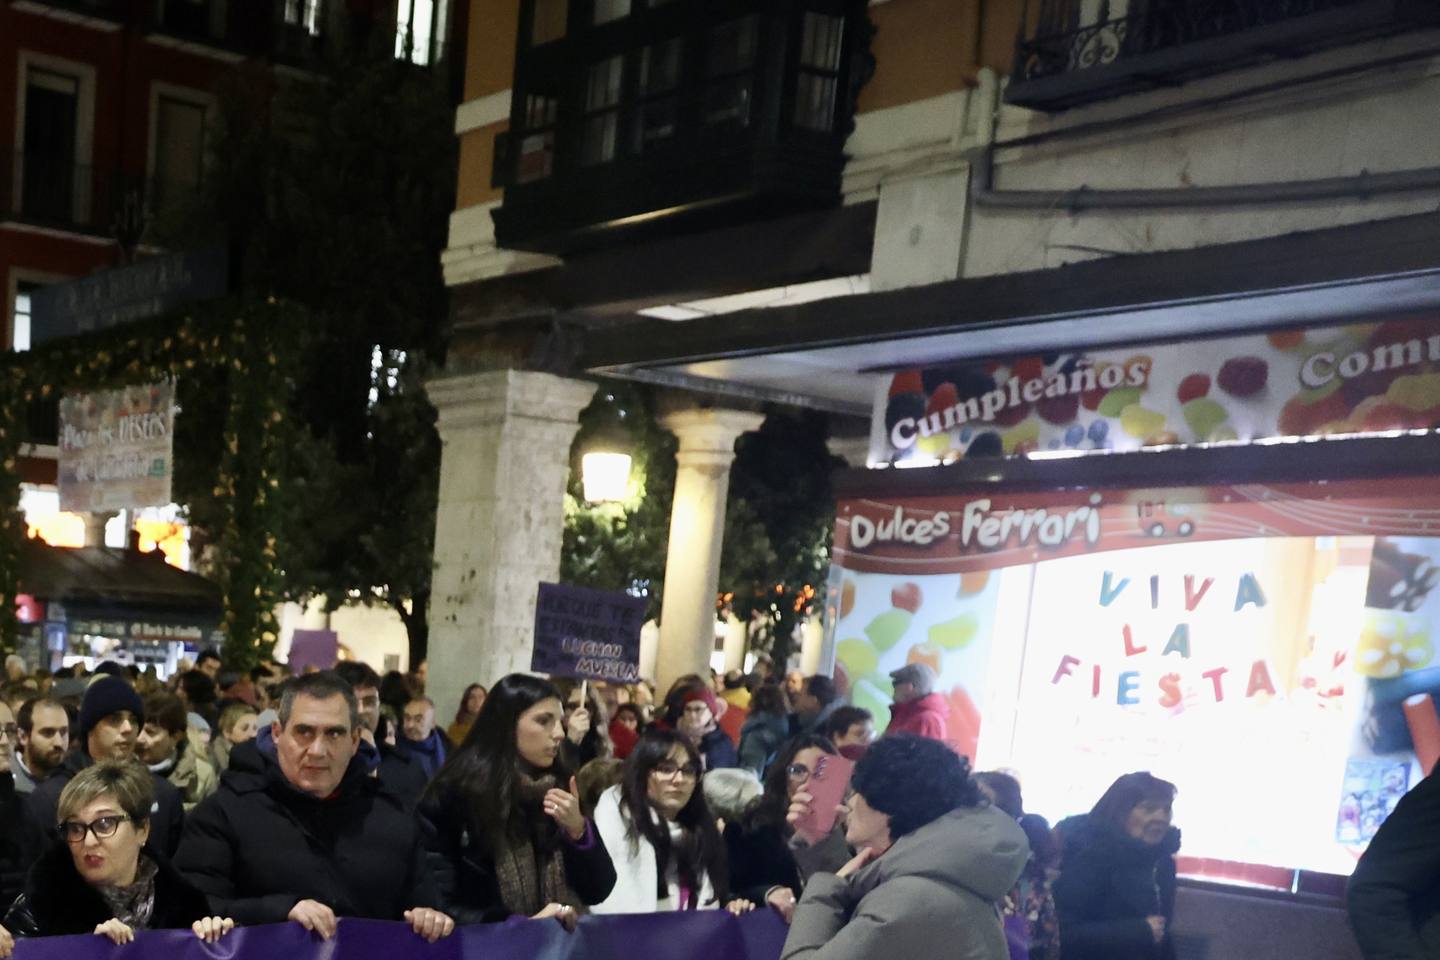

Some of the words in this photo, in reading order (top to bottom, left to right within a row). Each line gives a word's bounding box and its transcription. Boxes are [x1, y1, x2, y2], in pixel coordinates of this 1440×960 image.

[889, 354, 1148, 449] Cumpleaños
[850, 505, 950, 548] Dulces
[961, 493, 1102, 547] Ferrari
[1099, 570, 1267, 612] VIVA
[1122, 623, 1191, 659] LA
[1052, 655, 1276, 708] FIESTA
